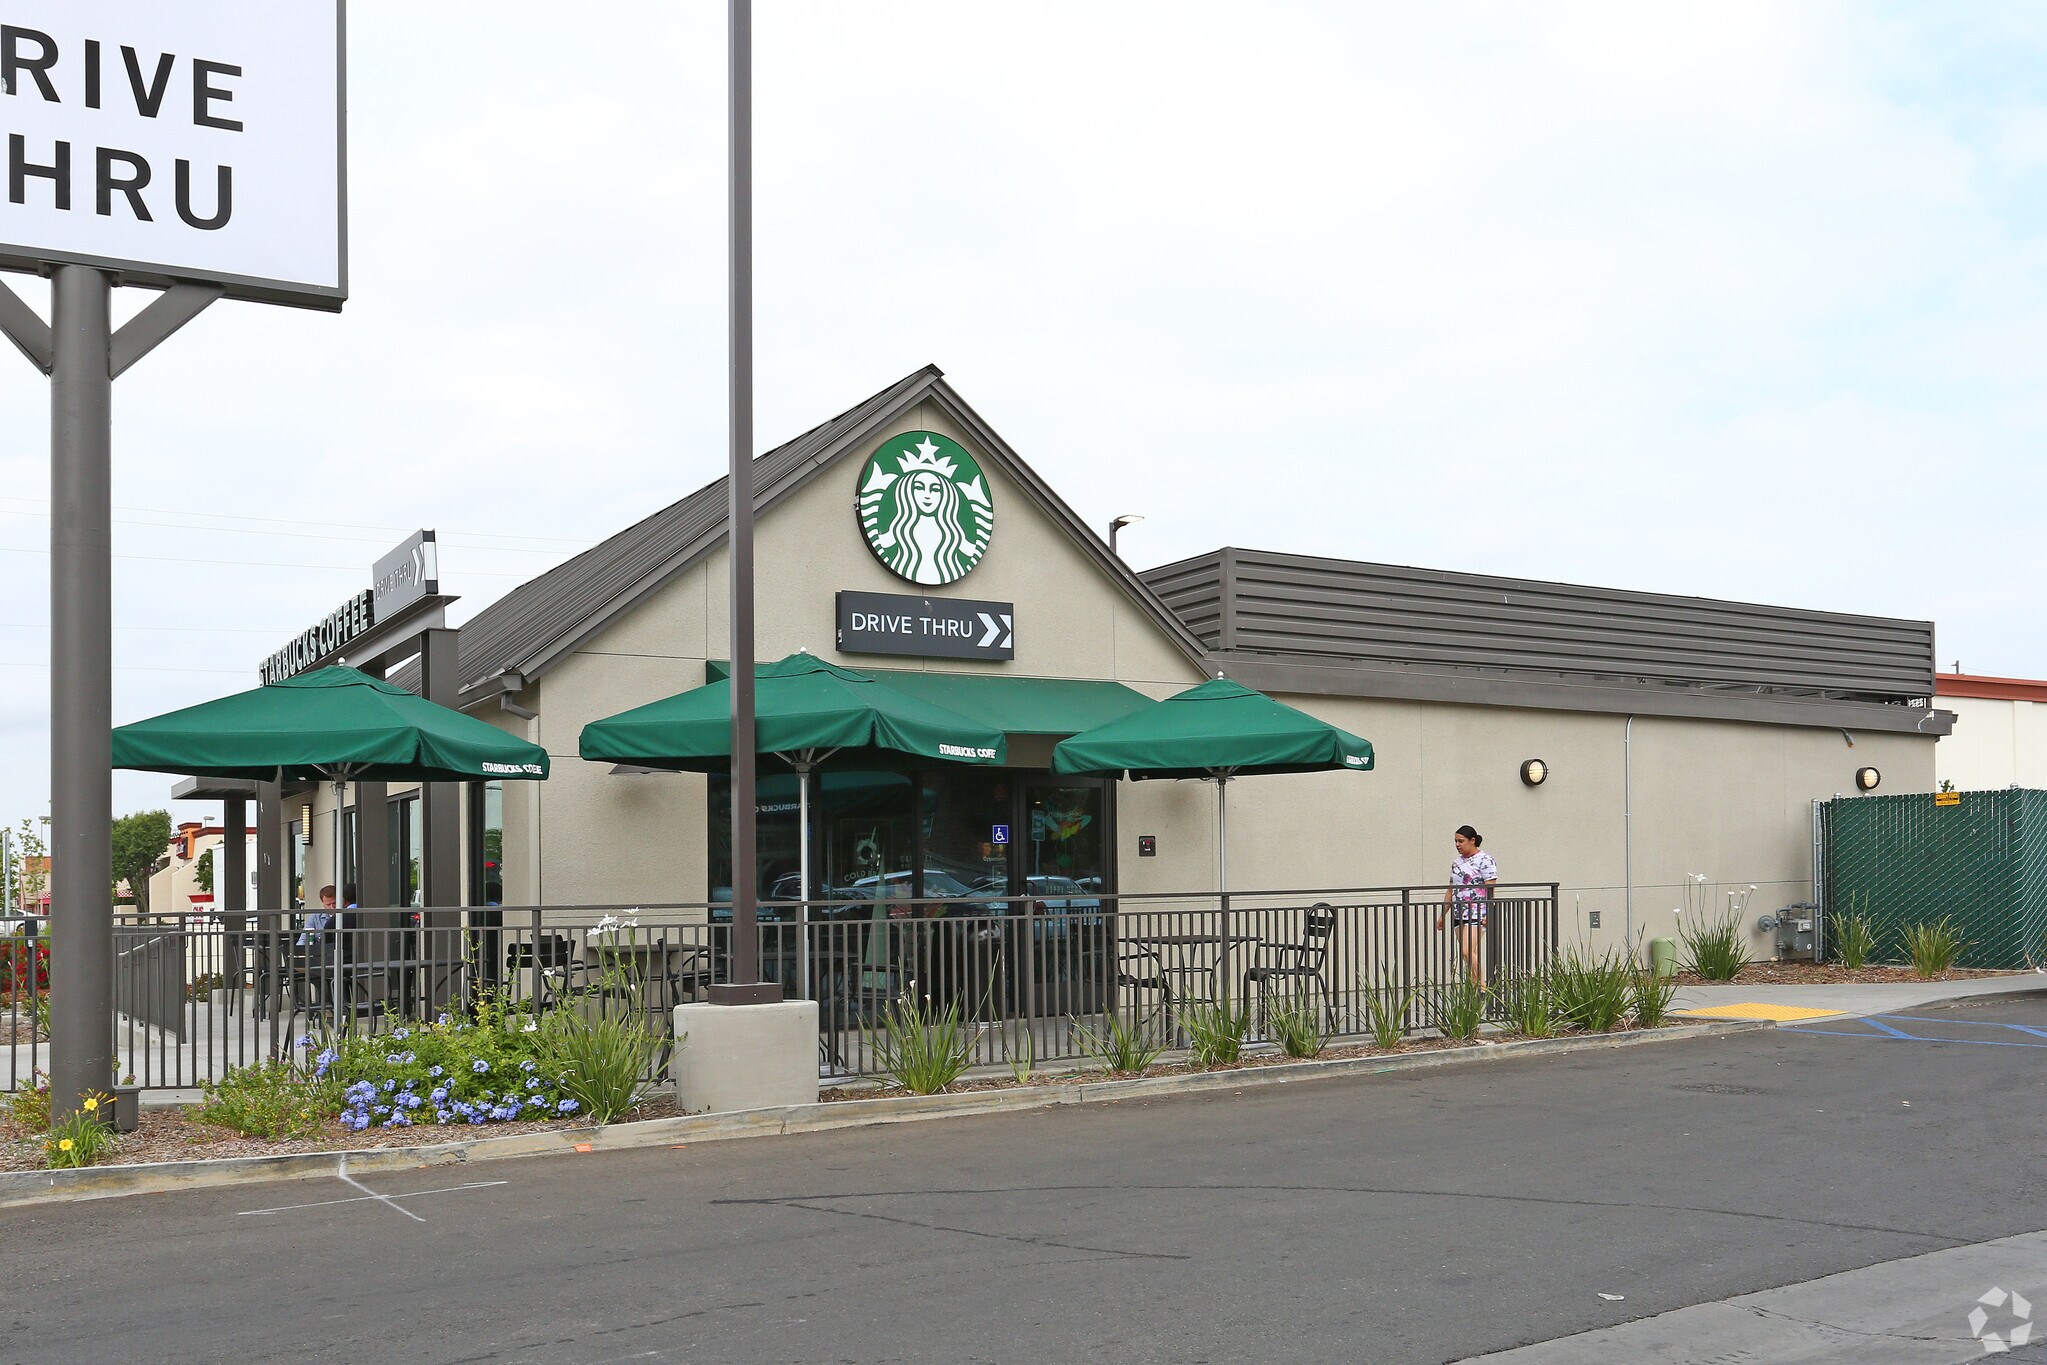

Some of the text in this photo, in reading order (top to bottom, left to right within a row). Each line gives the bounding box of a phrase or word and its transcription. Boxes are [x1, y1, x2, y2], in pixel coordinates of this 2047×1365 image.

[0, 24, 244, 133] RIVE
[8, 132, 232, 231] HRU
[375, 561, 411, 600] DRIVE THRU
[258, 589, 370, 687] STARBUCKS COFFEE
[851, 612, 973, 638] DRIVE THRU
[939, 744, 976, 758] STARBUCKS
[482, 762, 523, 774] STARBUCKS
[843, 869, 866, 882] COLD
